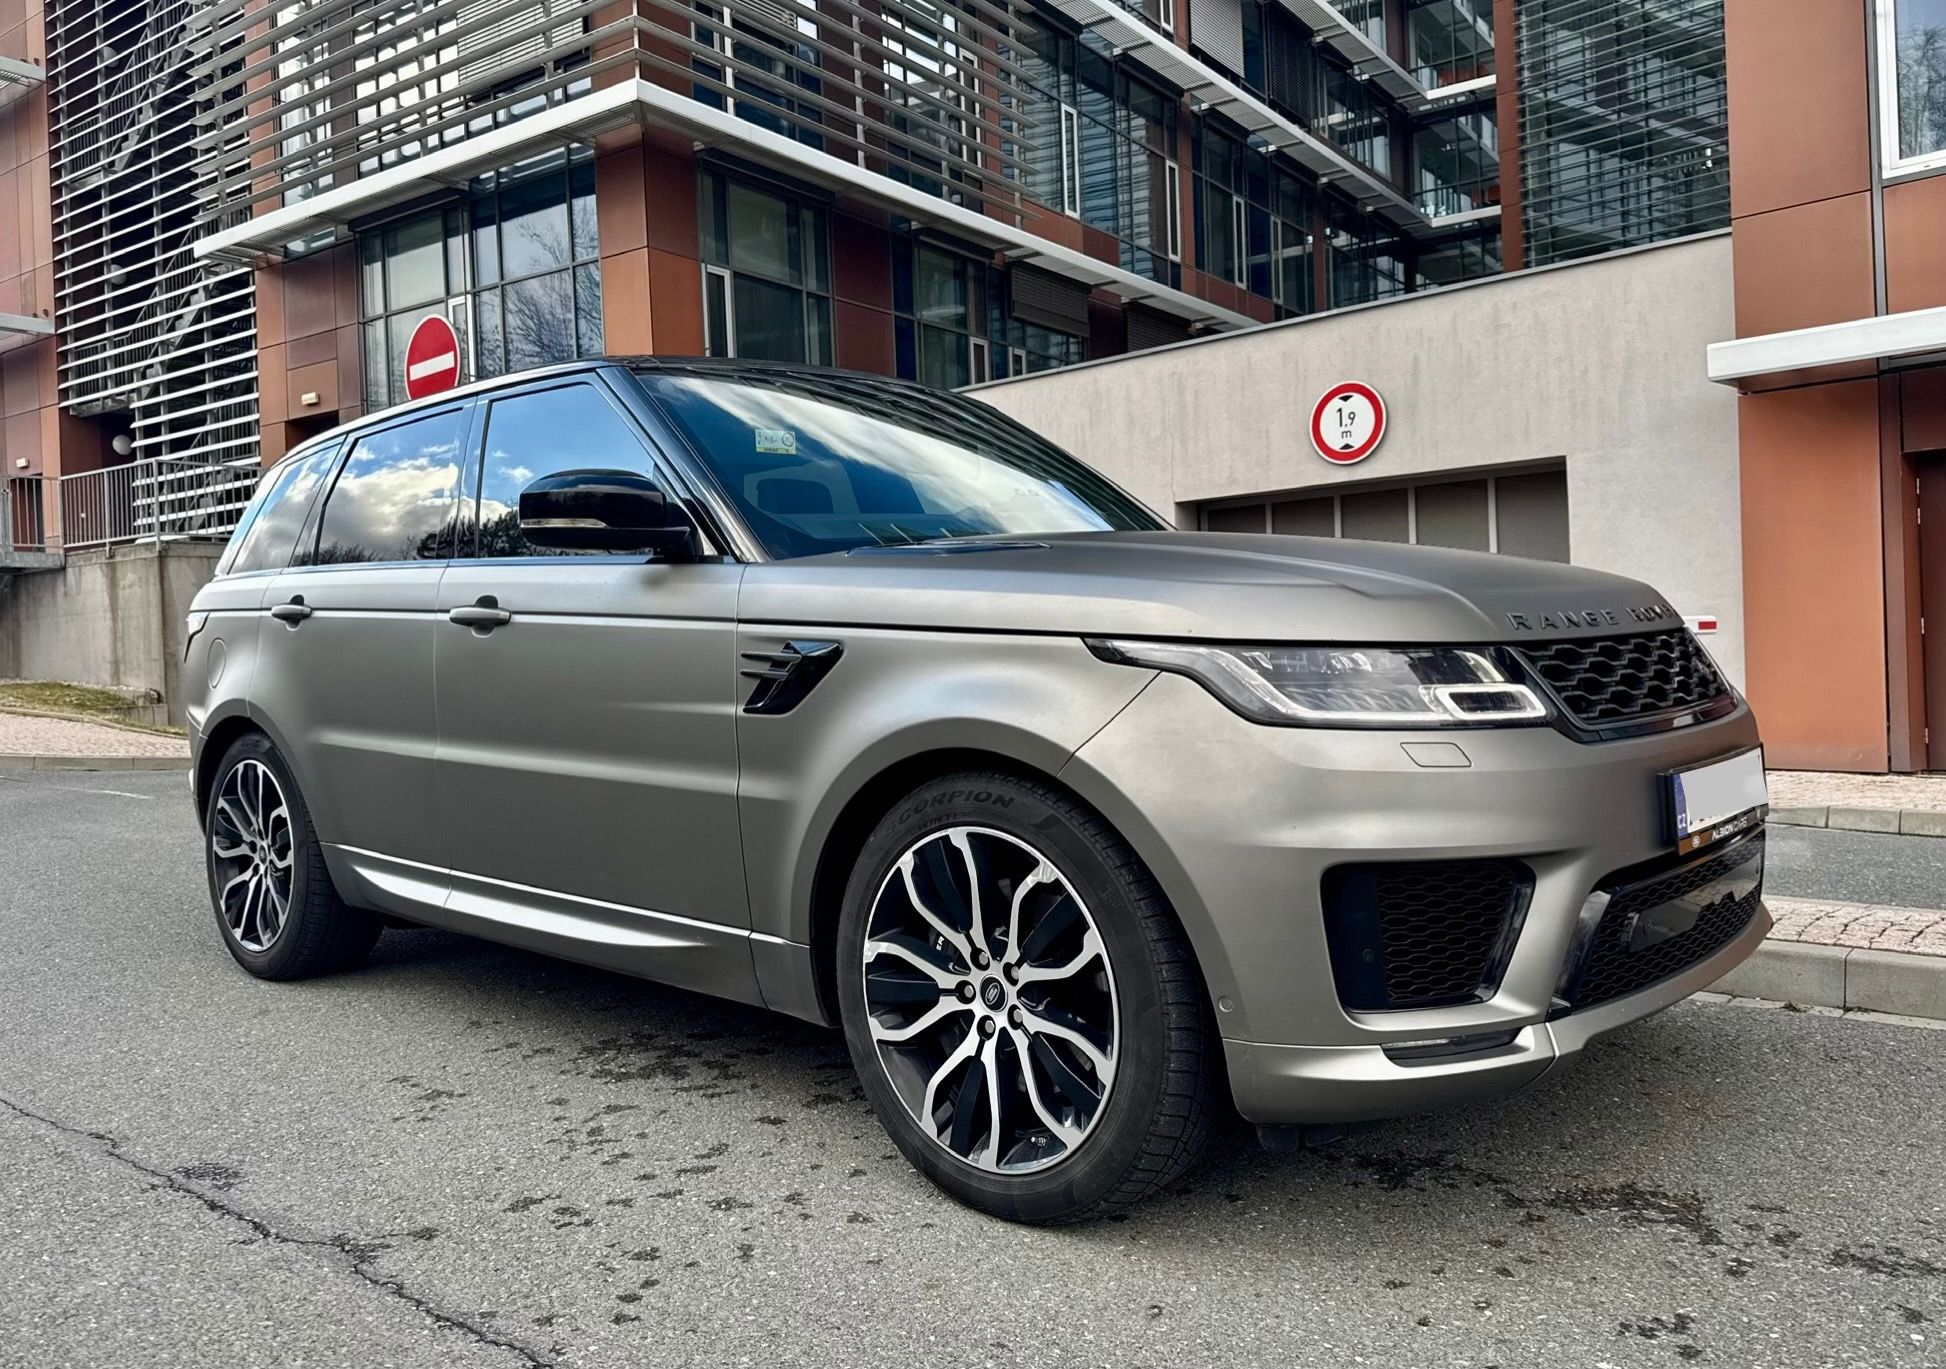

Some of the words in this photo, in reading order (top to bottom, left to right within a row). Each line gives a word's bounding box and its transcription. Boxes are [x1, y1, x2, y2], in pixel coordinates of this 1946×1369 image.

[1341, 430, 1352, 439] m
[1506, 608, 1619, 631] RANGE
[1677, 813, 1687, 829] CZ
